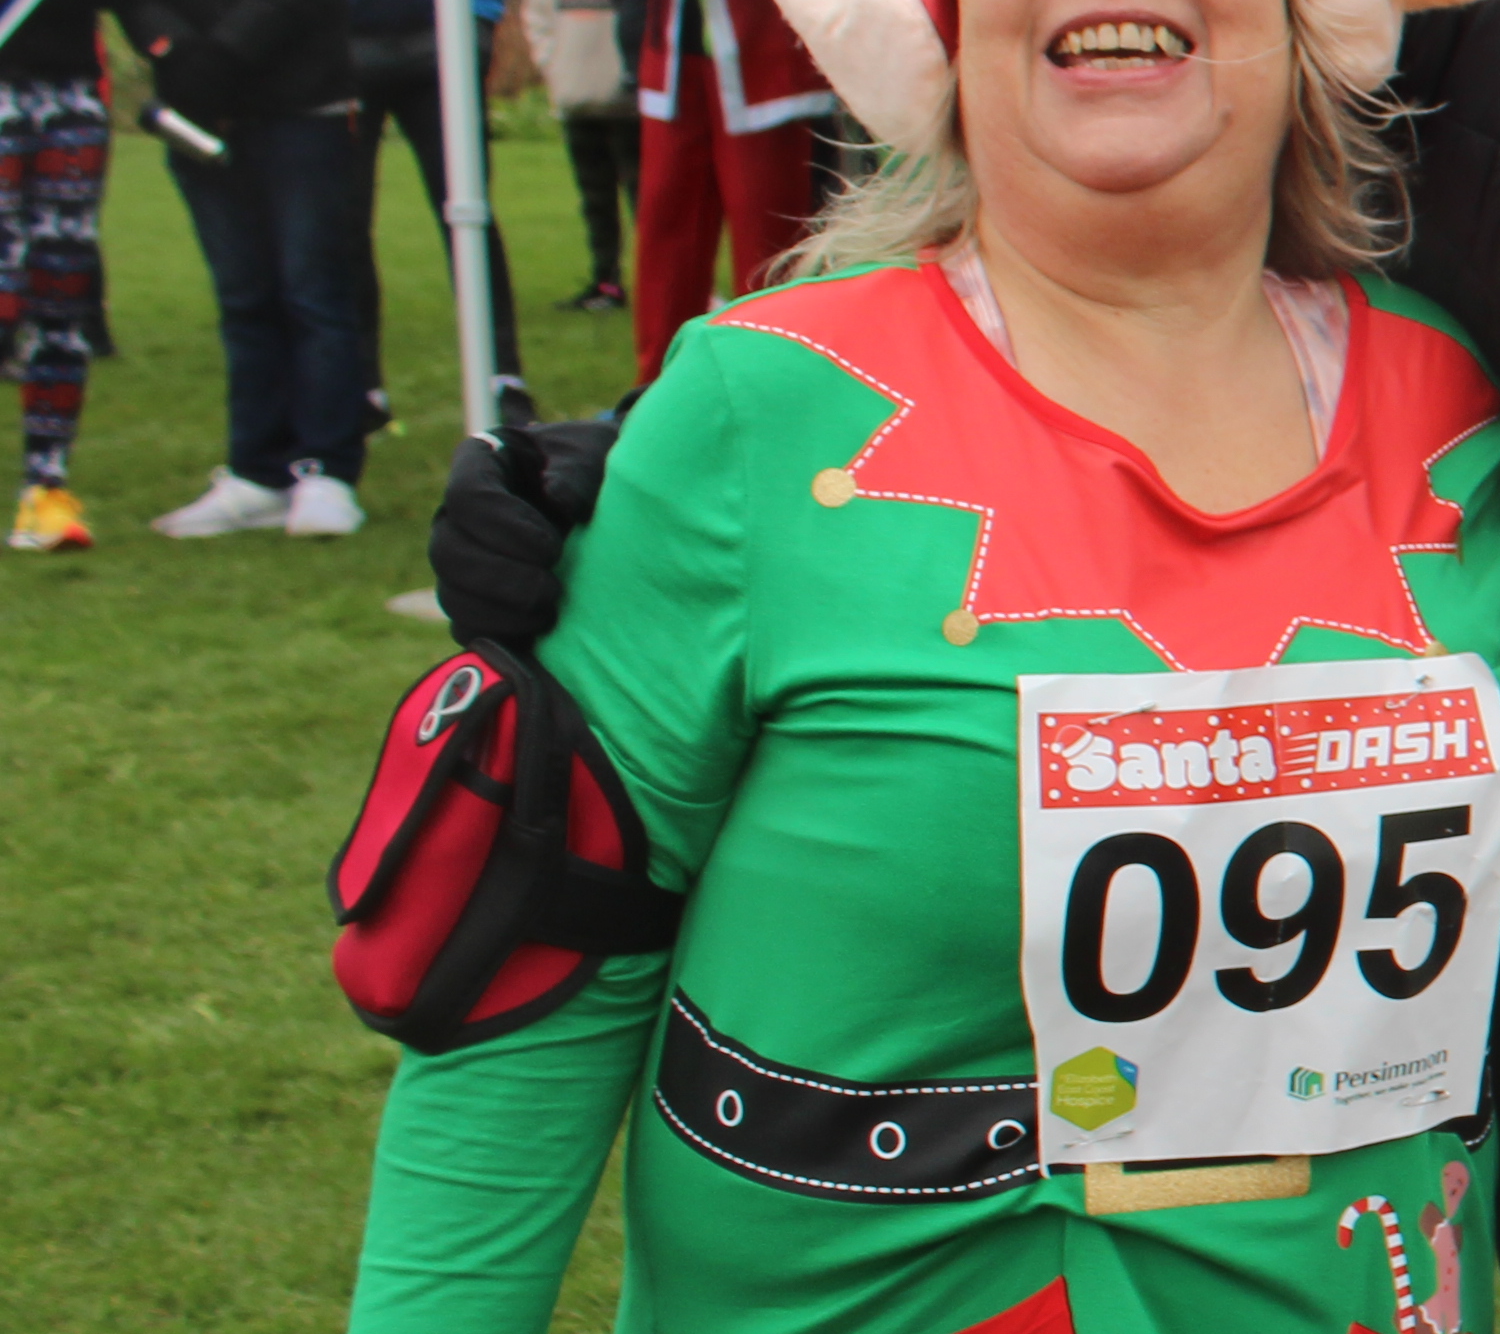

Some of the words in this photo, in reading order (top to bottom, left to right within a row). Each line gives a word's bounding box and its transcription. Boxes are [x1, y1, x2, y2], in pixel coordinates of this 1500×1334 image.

[1063, 727, 1278, 791] Santa
[1314, 719, 1469, 773] DASH
[1061, 804, 1473, 1024] 095
[1335, 1049, 1449, 1091] Persimmon
